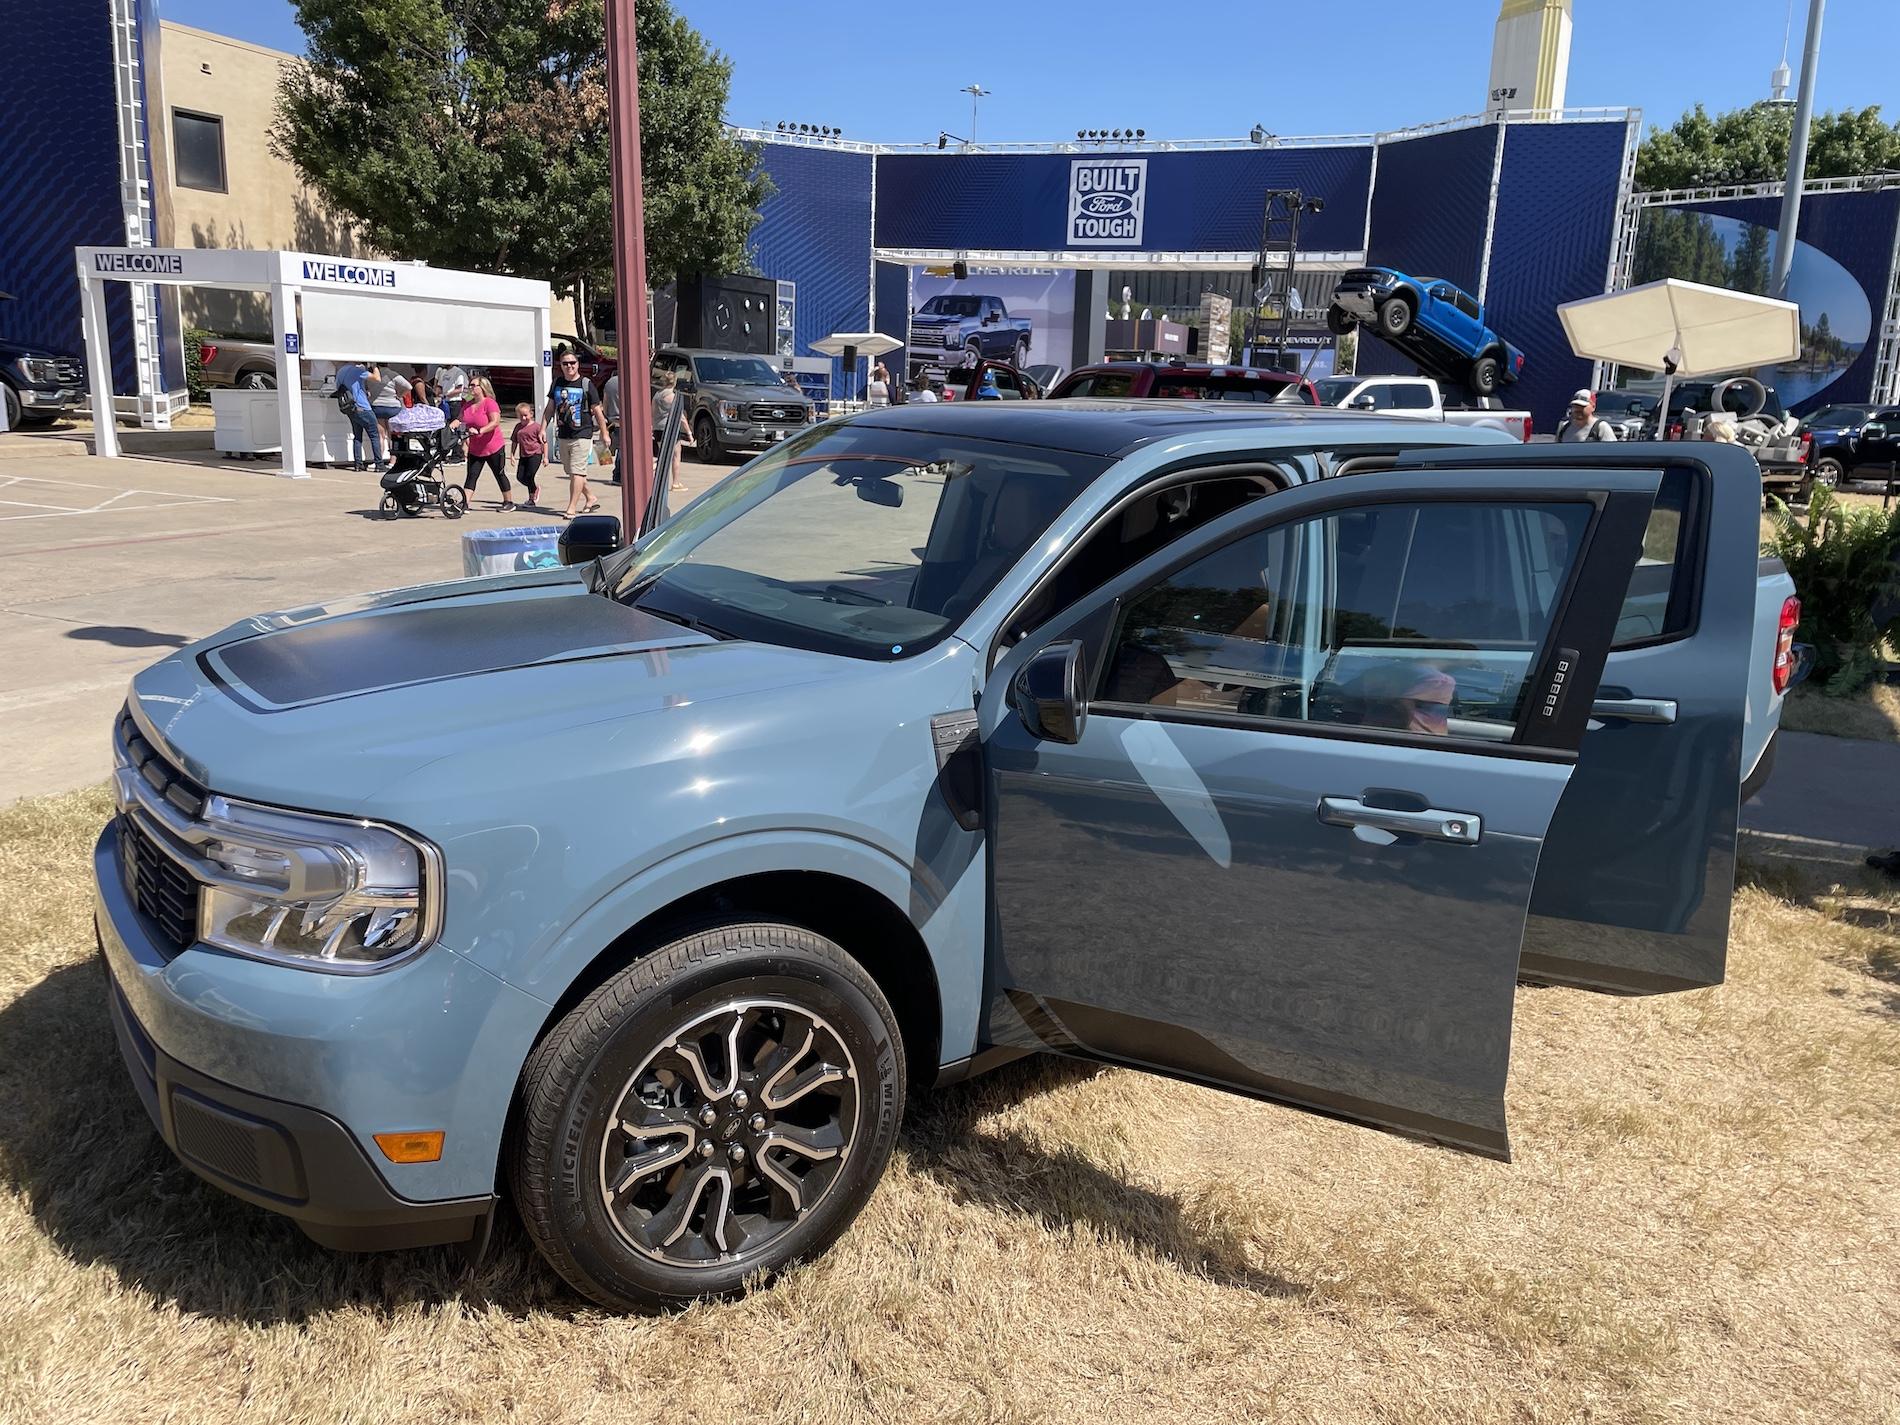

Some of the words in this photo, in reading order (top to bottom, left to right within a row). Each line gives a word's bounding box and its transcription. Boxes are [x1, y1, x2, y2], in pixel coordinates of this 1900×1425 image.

[1078, 168, 1139, 191] BUILT
[1089, 196, 1124, 212] Ford
[1075, 218, 1136, 237] TOUGH
[97, 254, 181, 273] WELCOME
[306, 261, 393, 287] WELCOME
[866, 1083, 893, 1179] MICHELIN
[560, 1087, 597, 1199] MICHELIN
